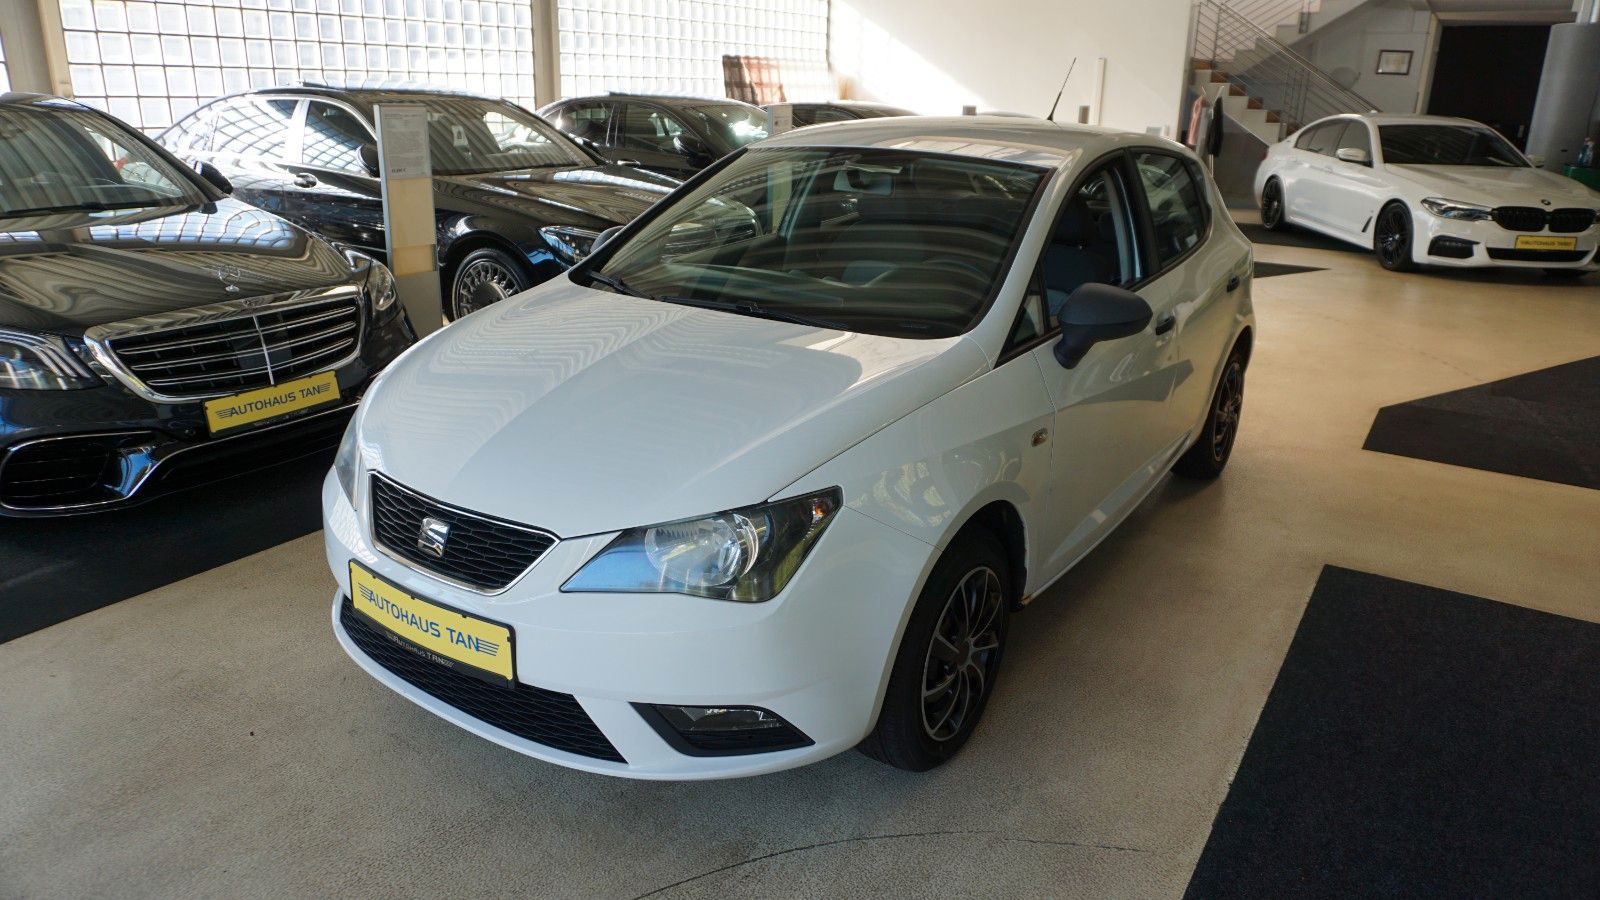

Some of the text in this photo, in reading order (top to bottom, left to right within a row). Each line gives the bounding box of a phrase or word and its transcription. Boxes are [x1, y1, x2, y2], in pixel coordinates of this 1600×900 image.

[230, 385, 321, 417] AUTOHAUS TAN
[369, 591, 481, 653] AUTOHAUS TAN
